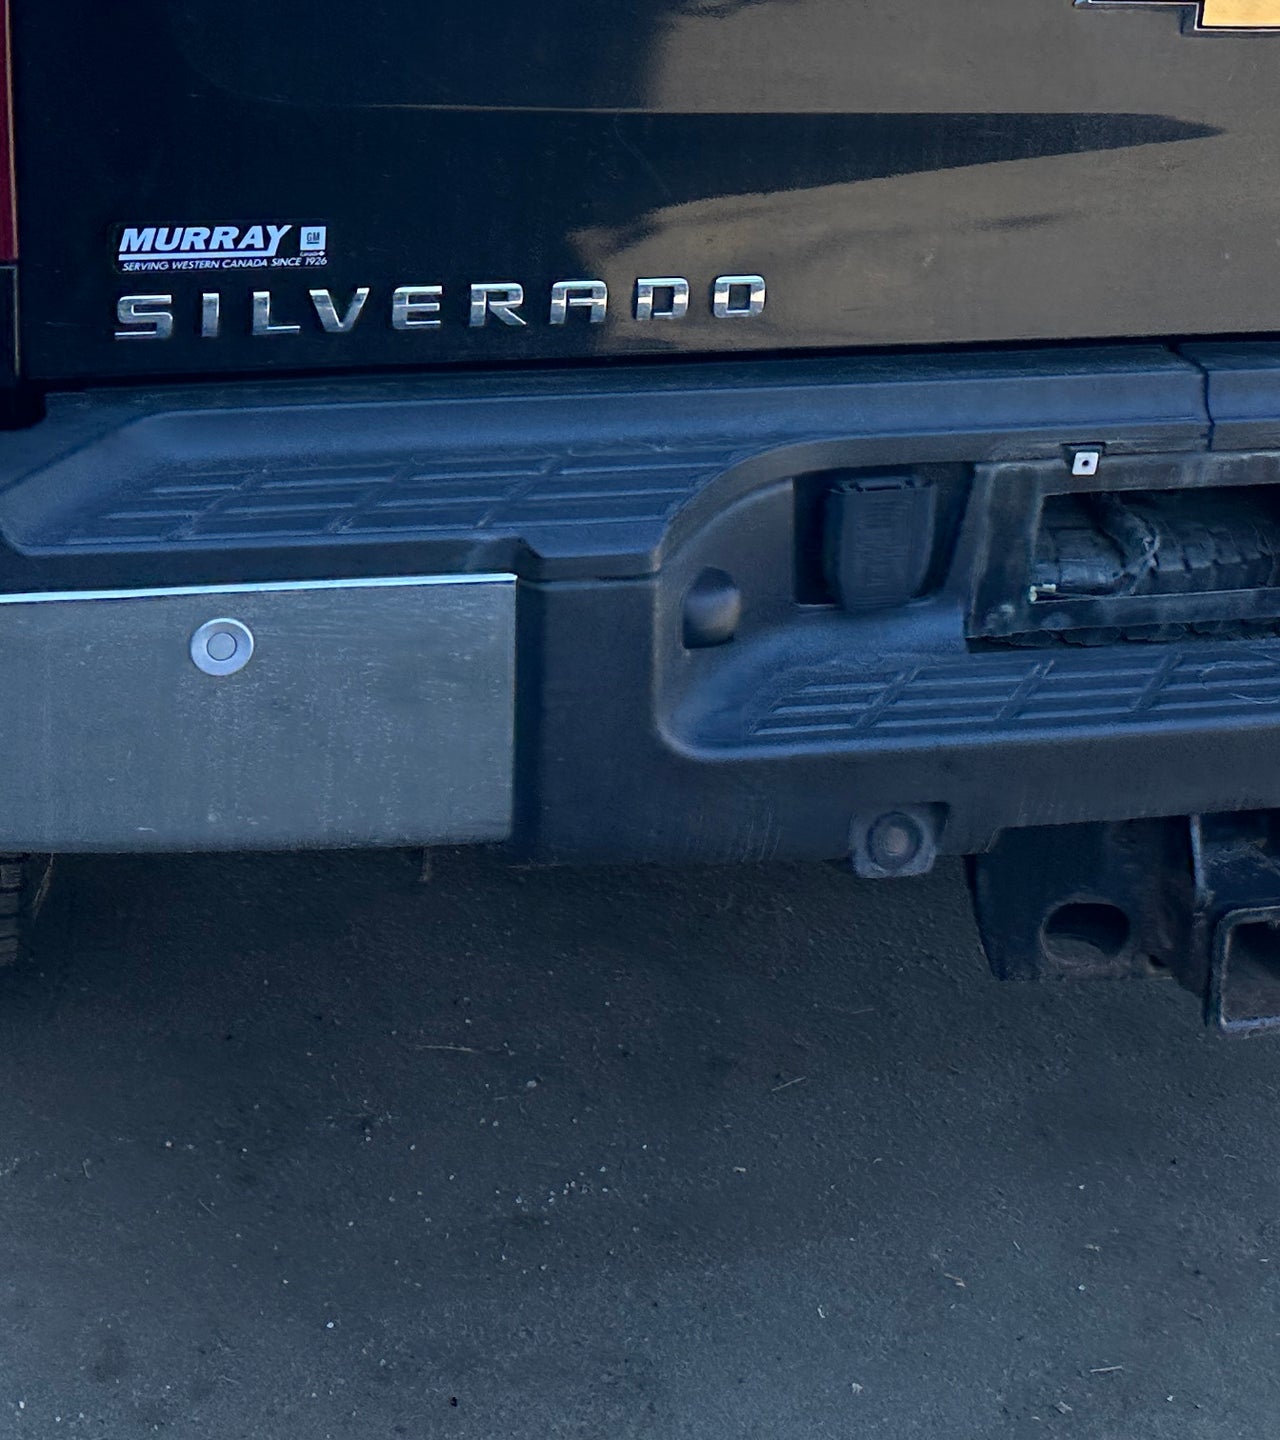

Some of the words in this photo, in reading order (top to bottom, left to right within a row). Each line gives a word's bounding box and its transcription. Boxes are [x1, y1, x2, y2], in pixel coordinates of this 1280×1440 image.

[119, 225, 292, 255] MURRAY
[122, 262, 169, 272] SERVING
[172, 260, 221, 270] WESTERN
[222, 259, 269, 269] CANADA
[271, 258, 302, 267] SINCE
[305, 256, 328, 266] 1926
[114, 274, 767, 340] SILVERADO
